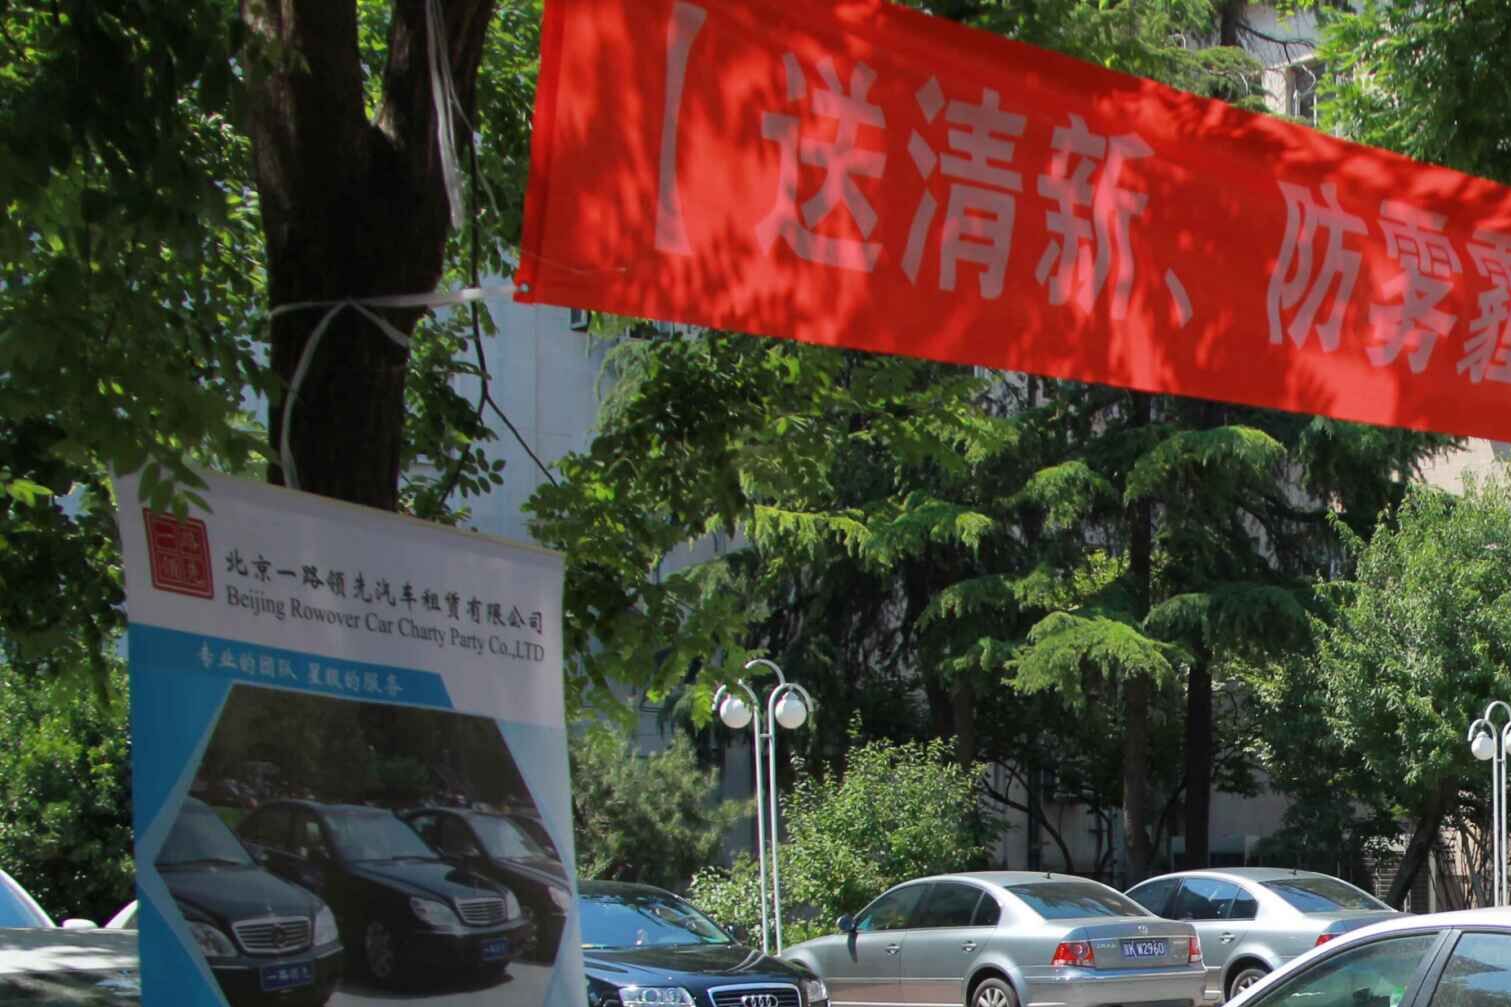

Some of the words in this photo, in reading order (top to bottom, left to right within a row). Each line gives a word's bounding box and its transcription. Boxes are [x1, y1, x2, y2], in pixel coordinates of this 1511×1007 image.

[225, 549, 543, 634] 北京一路领先汽车租赁有限公司
[225, 585, 286, 620] Beijing
[291, 598, 360, 630] Rowover
[365, 612, 393, 634] Car
[398, 616, 447, 647] Charty
[450, 632, 485, 656] Party
